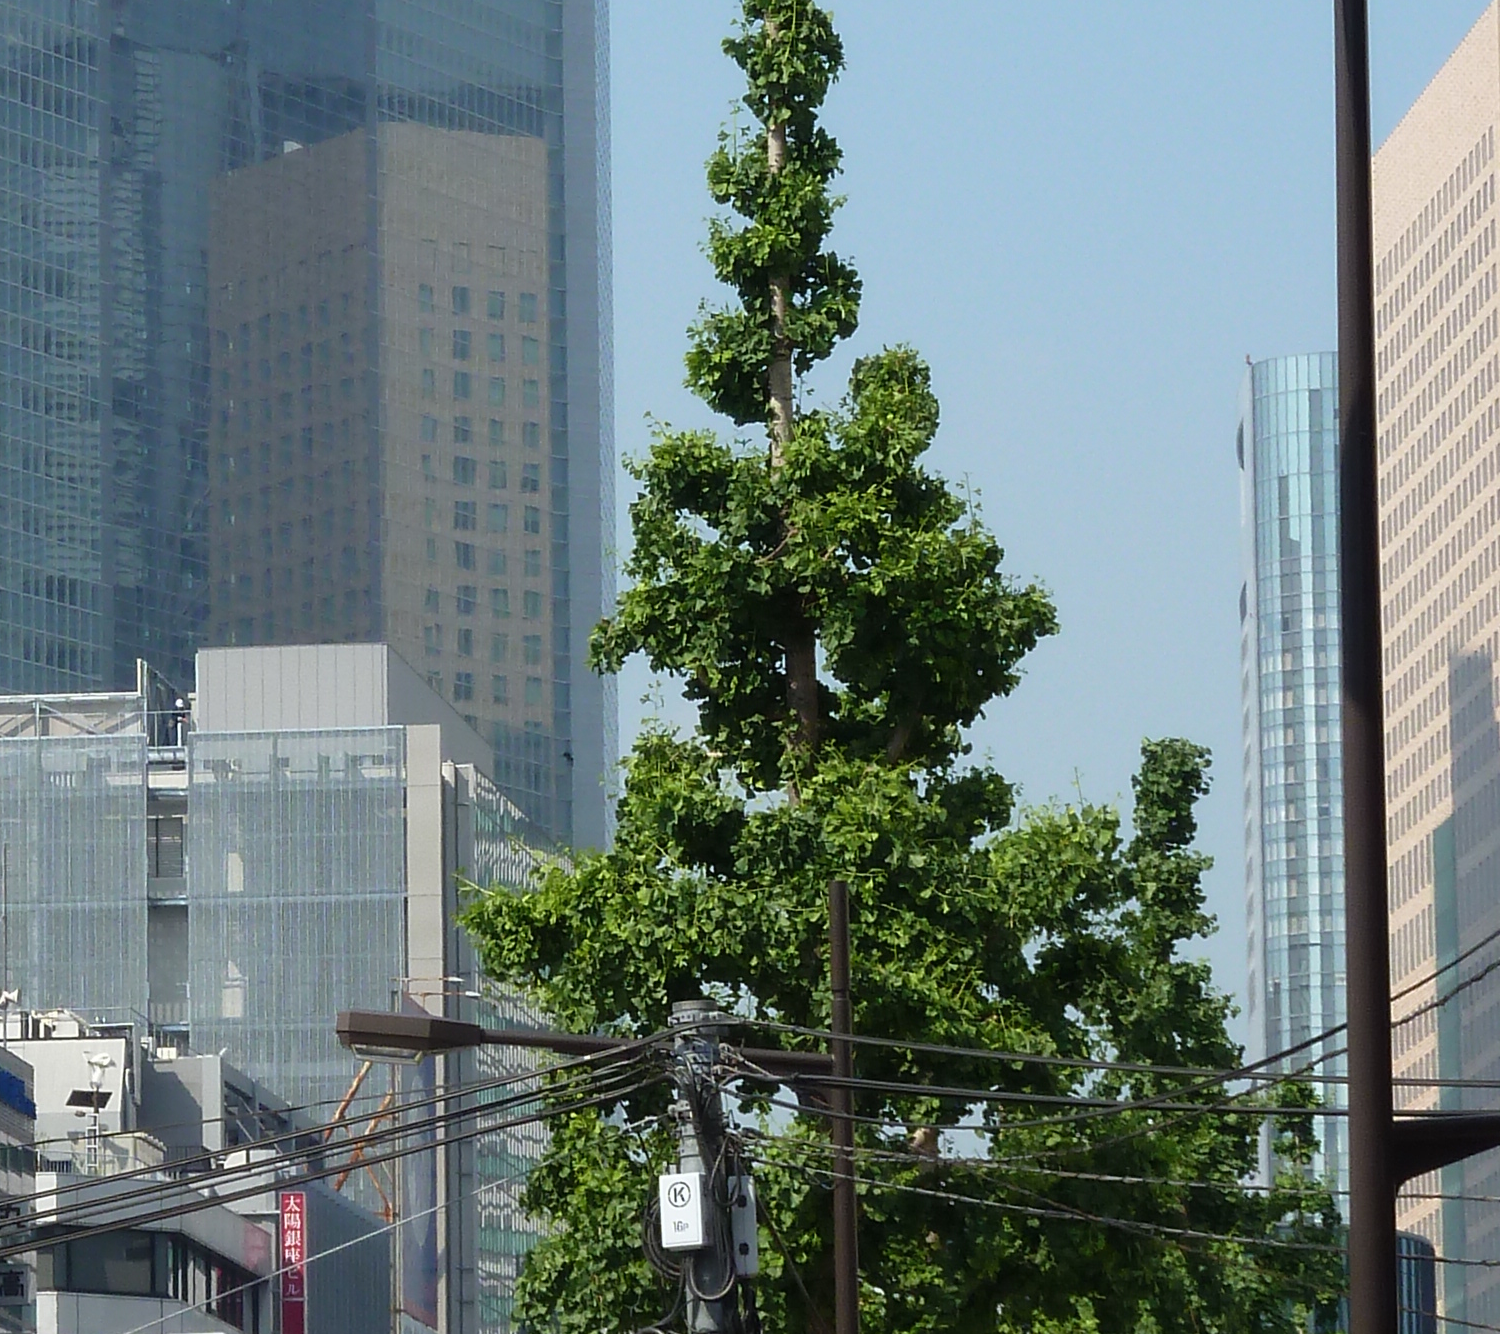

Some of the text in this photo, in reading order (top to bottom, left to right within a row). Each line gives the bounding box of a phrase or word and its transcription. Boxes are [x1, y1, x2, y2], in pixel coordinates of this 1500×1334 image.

[283, 1195, 302, 1296] 太陽銀座ビル
